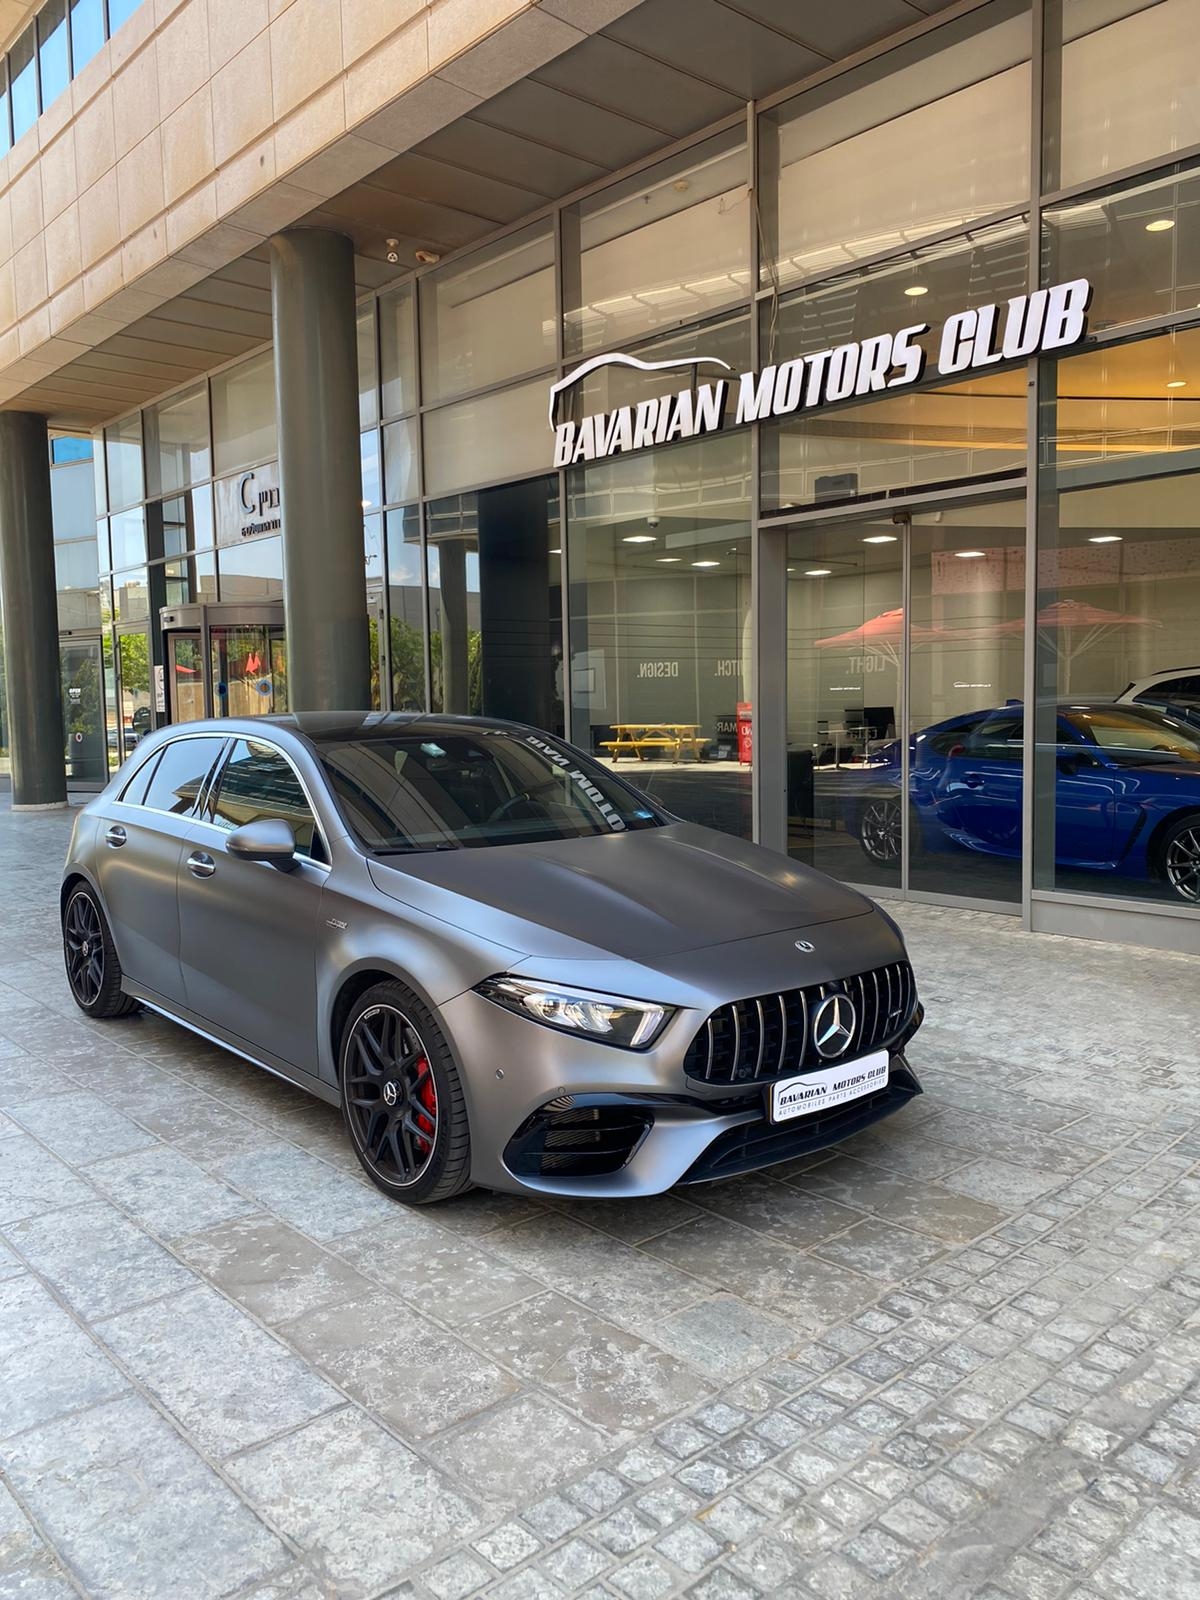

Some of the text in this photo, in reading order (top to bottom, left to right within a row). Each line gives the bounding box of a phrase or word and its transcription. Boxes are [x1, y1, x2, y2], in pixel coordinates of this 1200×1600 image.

[553, 278, 1092, 468] BAVARIAN MOTORS CLUB
[240, 472, 255, 514] C
[779, 1077, 886, 1116] AUTOMOBILES PARTS ACCESSORIES
[780, 1065, 887, 1106] BAVARIAN MOTORS CLUB
